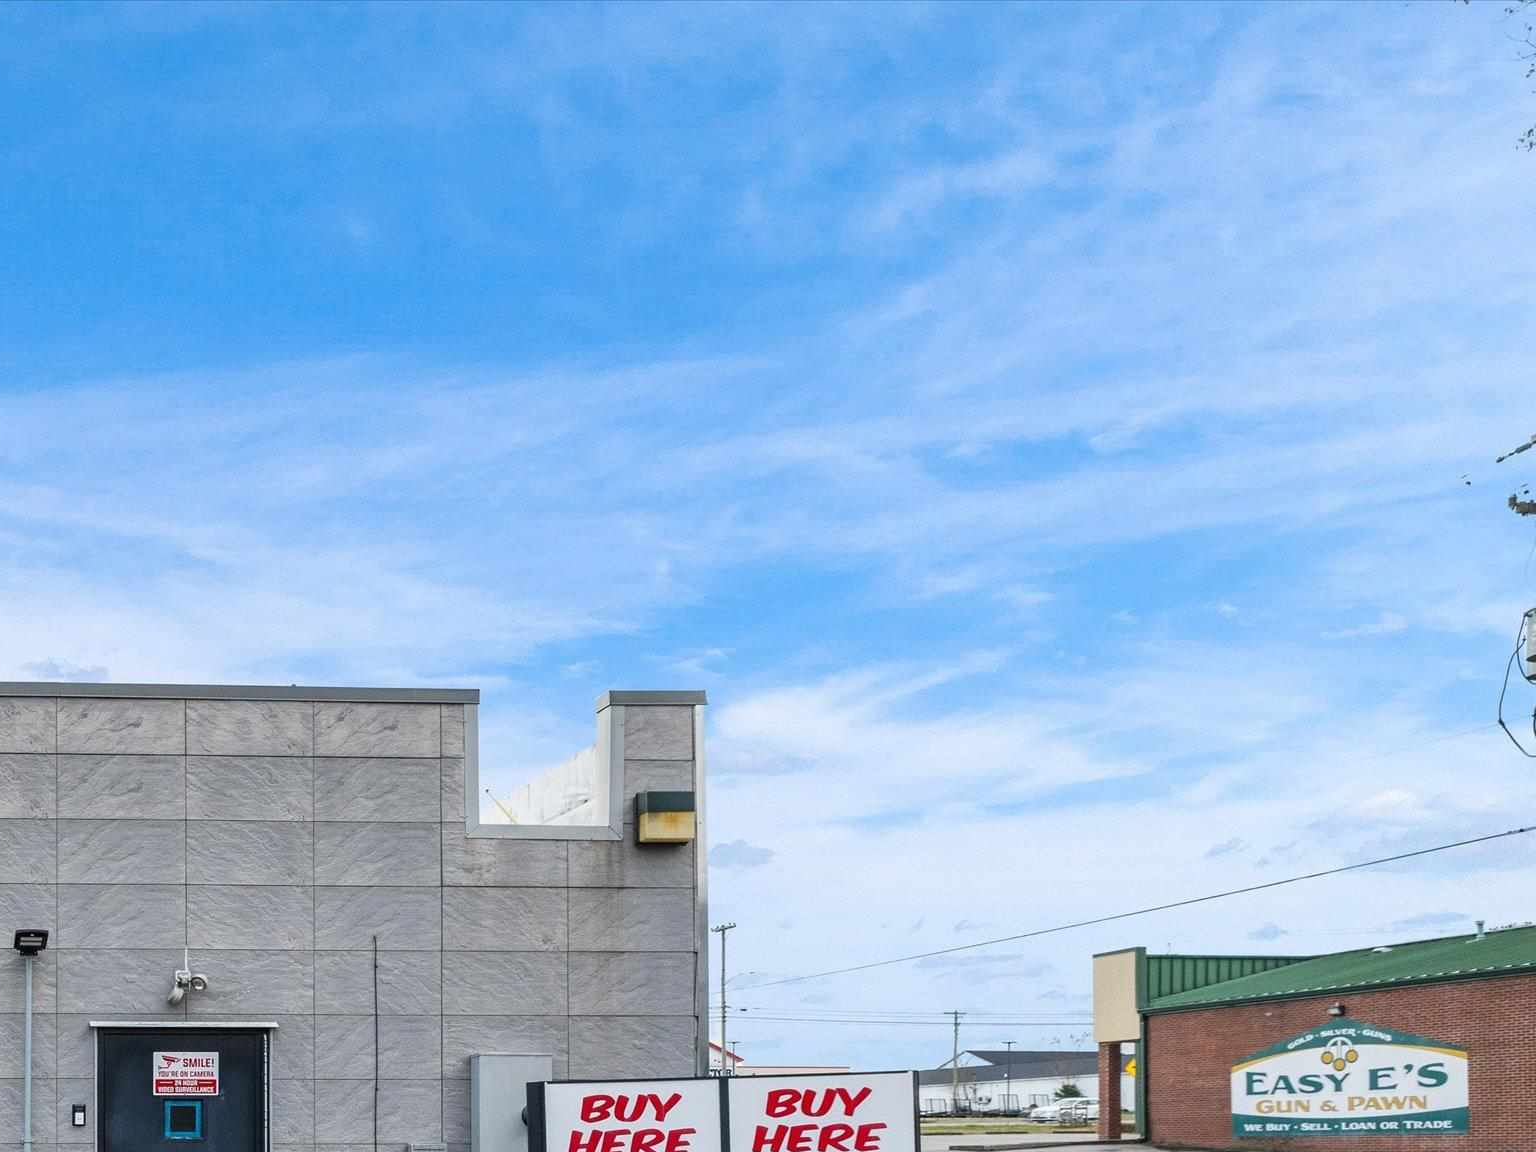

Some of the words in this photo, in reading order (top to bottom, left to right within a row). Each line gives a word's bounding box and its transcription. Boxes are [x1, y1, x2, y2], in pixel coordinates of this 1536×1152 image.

[1287, 1034, 1314, 1049] GOLD
[1320, 1028, 1356, 1037] SILVER
[1362, 1028, 1392, 1042] GUNS
[182, 1058, 215, 1068] SMILE!
[180, 1070, 188, 1078] ON
[190, 1070, 214, 1078] CAMERA
[1245, 1071, 1350, 1096] EASY
[1368, 1062, 1449, 1091] E'S
[579, 1093, 682, 1123] BUY
[765, 1087, 873, 1119] BUY
[1255, 1099, 1311, 1114] GUN
[1320, 1100, 1338, 1112] &
[1347, 1096, 1427, 1111] PAWN
[1243, 1123, 1264, 1132] WE
[1265, 1123, 1292, 1132] BUY
[1299, 1122, 1332, 1131] SELL
[1341, 1121, 1377, 1130] LOAN
[1379, 1121, 1399, 1130] OR
[1402, 1120, 1454, 1129] TRADE
